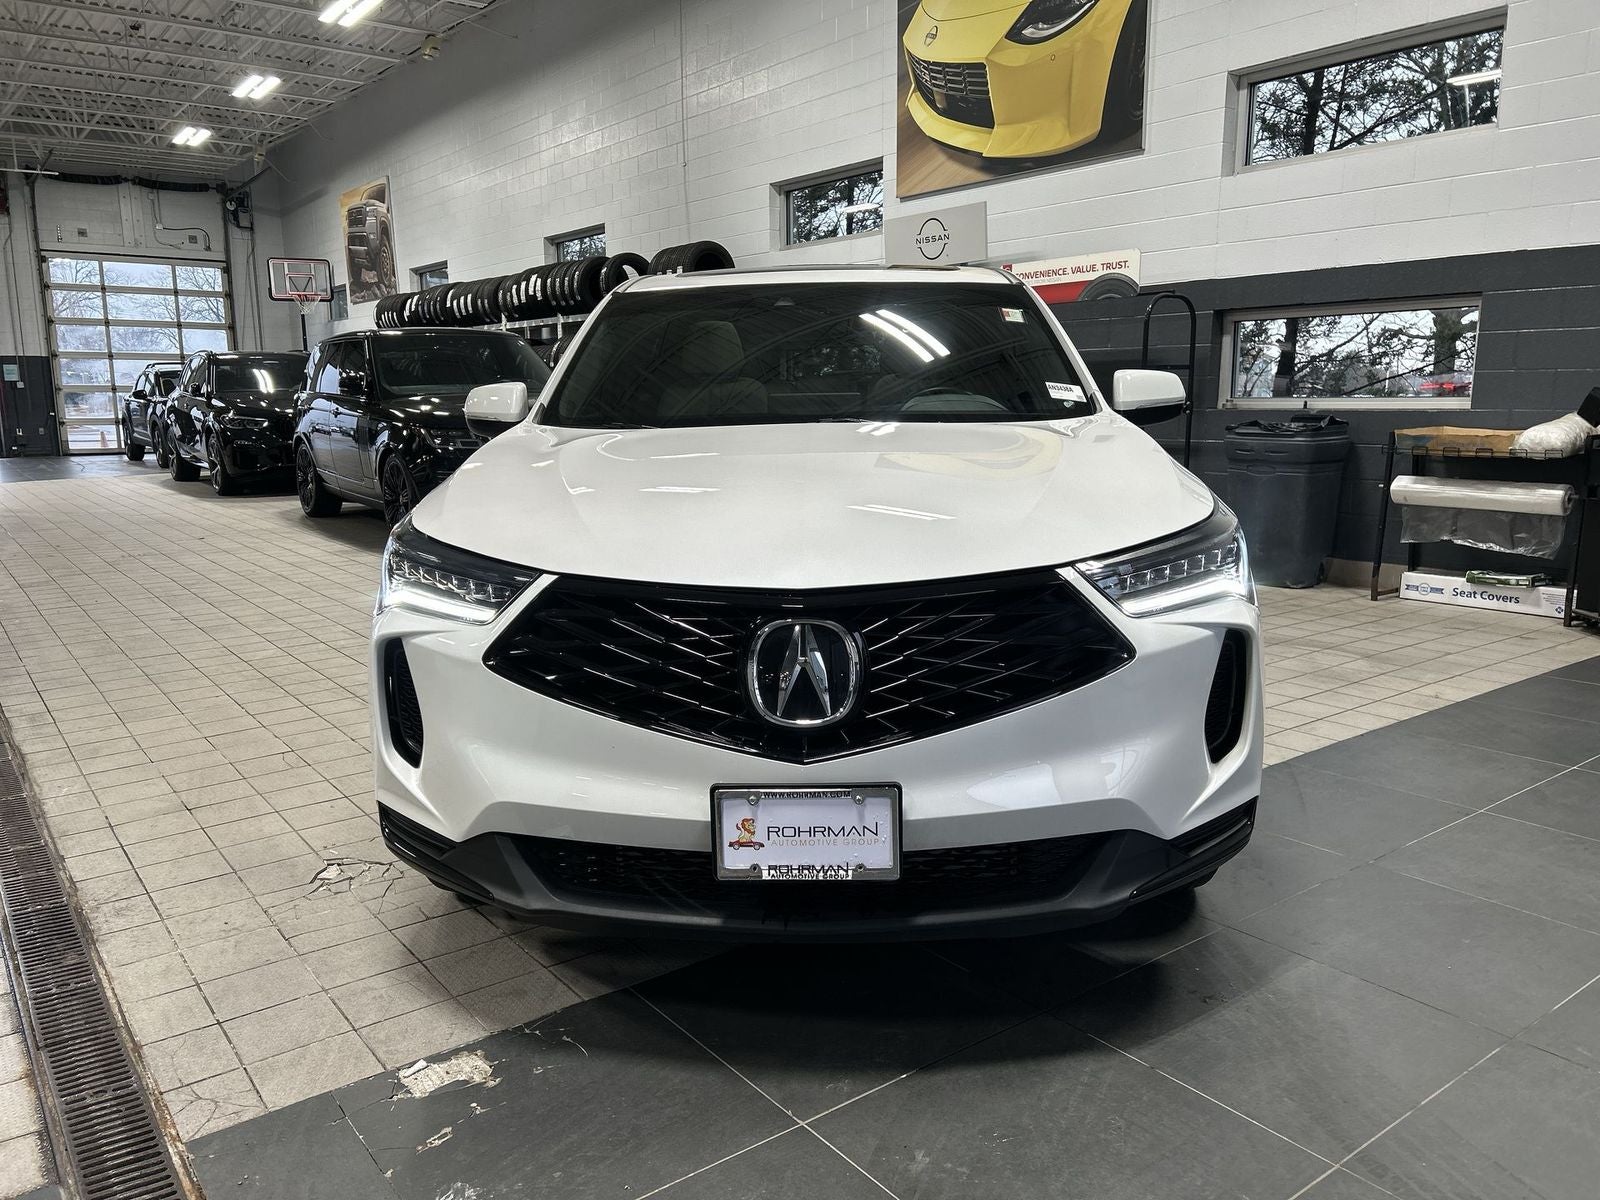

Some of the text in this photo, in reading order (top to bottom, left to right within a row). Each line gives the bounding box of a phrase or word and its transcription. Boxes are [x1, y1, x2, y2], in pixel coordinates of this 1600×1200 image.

[916, 233, 950, 245] NISSAN
[1071, 263, 1099, 275] VALUE.
[1101, 260, 1130, 271] TRUST.
[1452, 587, 1478, 599] Seat
[1480, 591, 1520, 604] Covers
[762, 791, 851, 799] WWW.ROHRMAN.COM
[767, 822, 878, 841] ROHRMAN
[771, 838, 880, 847] AUTOMOTIVE GROUP
[767, 862, 849, 876] ROHRMAN
